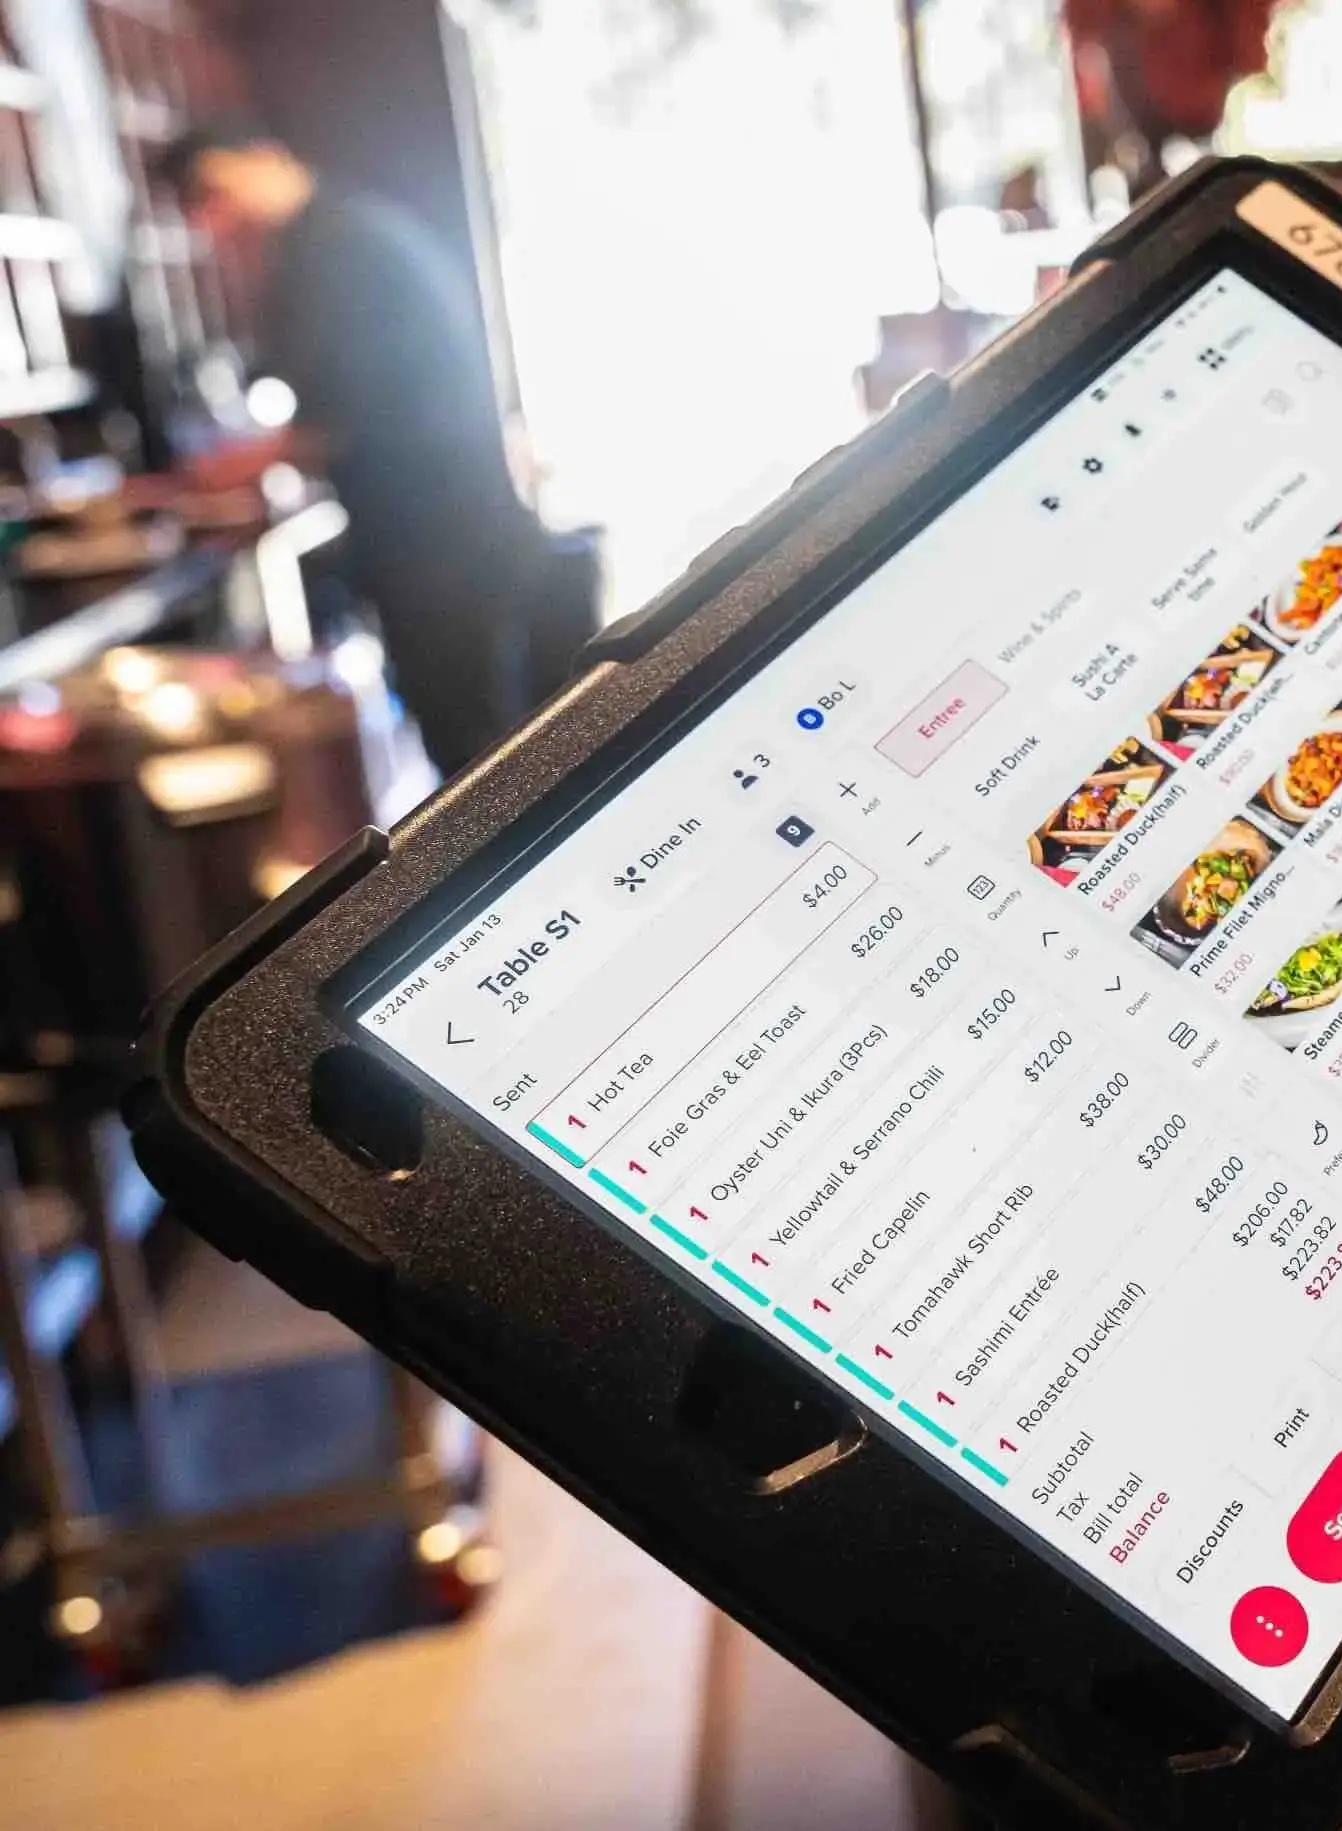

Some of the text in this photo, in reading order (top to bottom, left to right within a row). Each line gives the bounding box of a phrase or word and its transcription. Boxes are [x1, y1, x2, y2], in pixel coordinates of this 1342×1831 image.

[998, 633, 1033, 663] Wine
[1030, 622, 1045, 634] &
[1071, 643, 1119, 687] Sushi A
[817, 679, 856, 710] Bo L
[1085, 653, 1138, 701] La Carte
[918, 698, 966, 739] Entree
[753, 753, 771, 768] 3
[975, 735, 1041, 797] Soft Drink
[1195, 723, 1243, 770] Roasted
[786, 825, 801, 836] 9
[861, 797, 881, 816] Add
[639, 817, 702, 869] Dine In
[1077, 784, 1187, 895] Roasted Duck(half)
[987, 889, 1022, 921] Quantity
[1101, 872, 1142, 912] $48.00
[372, 995, 407, 1025] 3:24
[433, 950, 460, 972] Sat
[458, 929, 485, 952] Jan
[481, 913, 502, 929] 13
[477, 909, 582, 997] Table S1
[1064, 947, 1079, 961] Up
[1189, 939, 1228, 977] Prime
[1222, 910, 1253, 939] Filet
[566, 864, 848, 1130] 1 Hot Tea $4.00
[1214, 953, 1253, 994] $32.00
[502, 990, 530, 1014] 28
[1125, 991, 1151, 1016] Down
[628, 906, 904, 1176] 1 Foie Gras & Eel Toast $26.00
[1192, 1038, 1220, 1068] Divider
[492, 1072, 538, 1112] Sent
[689, 947, 960, 1222] 1 Oyster Uni & Ikura (3Pcs) $18.00
[750, 988, 1017, 1268] 1 Yellowtail & Serrano Chili $15.00
[812, 1030, 1074, 1314] 1 Fried Capelin $12.00
[873, 1072, 1130, 1360] 1 Tomahawk Short Rib $38.00
[936, 1113, 1187, 1407] 1 Sashimi Entrée $30.00
[998, 1155, 1245, 1454] 1 Roasted Duck(half) $48.00
[1031, 1181, 1289, 1505] Subtotal $206.00
[1056, 1198, 1314, 1522] Tax $17.82
[1083, 1215, 1337, 1544] Bill total $223.82
[1273, 1407, 1310, 1448] Print
[1109, 1490, 1171, 1564] Balance
[1176, 1498, 1244, 1584] Discounts
